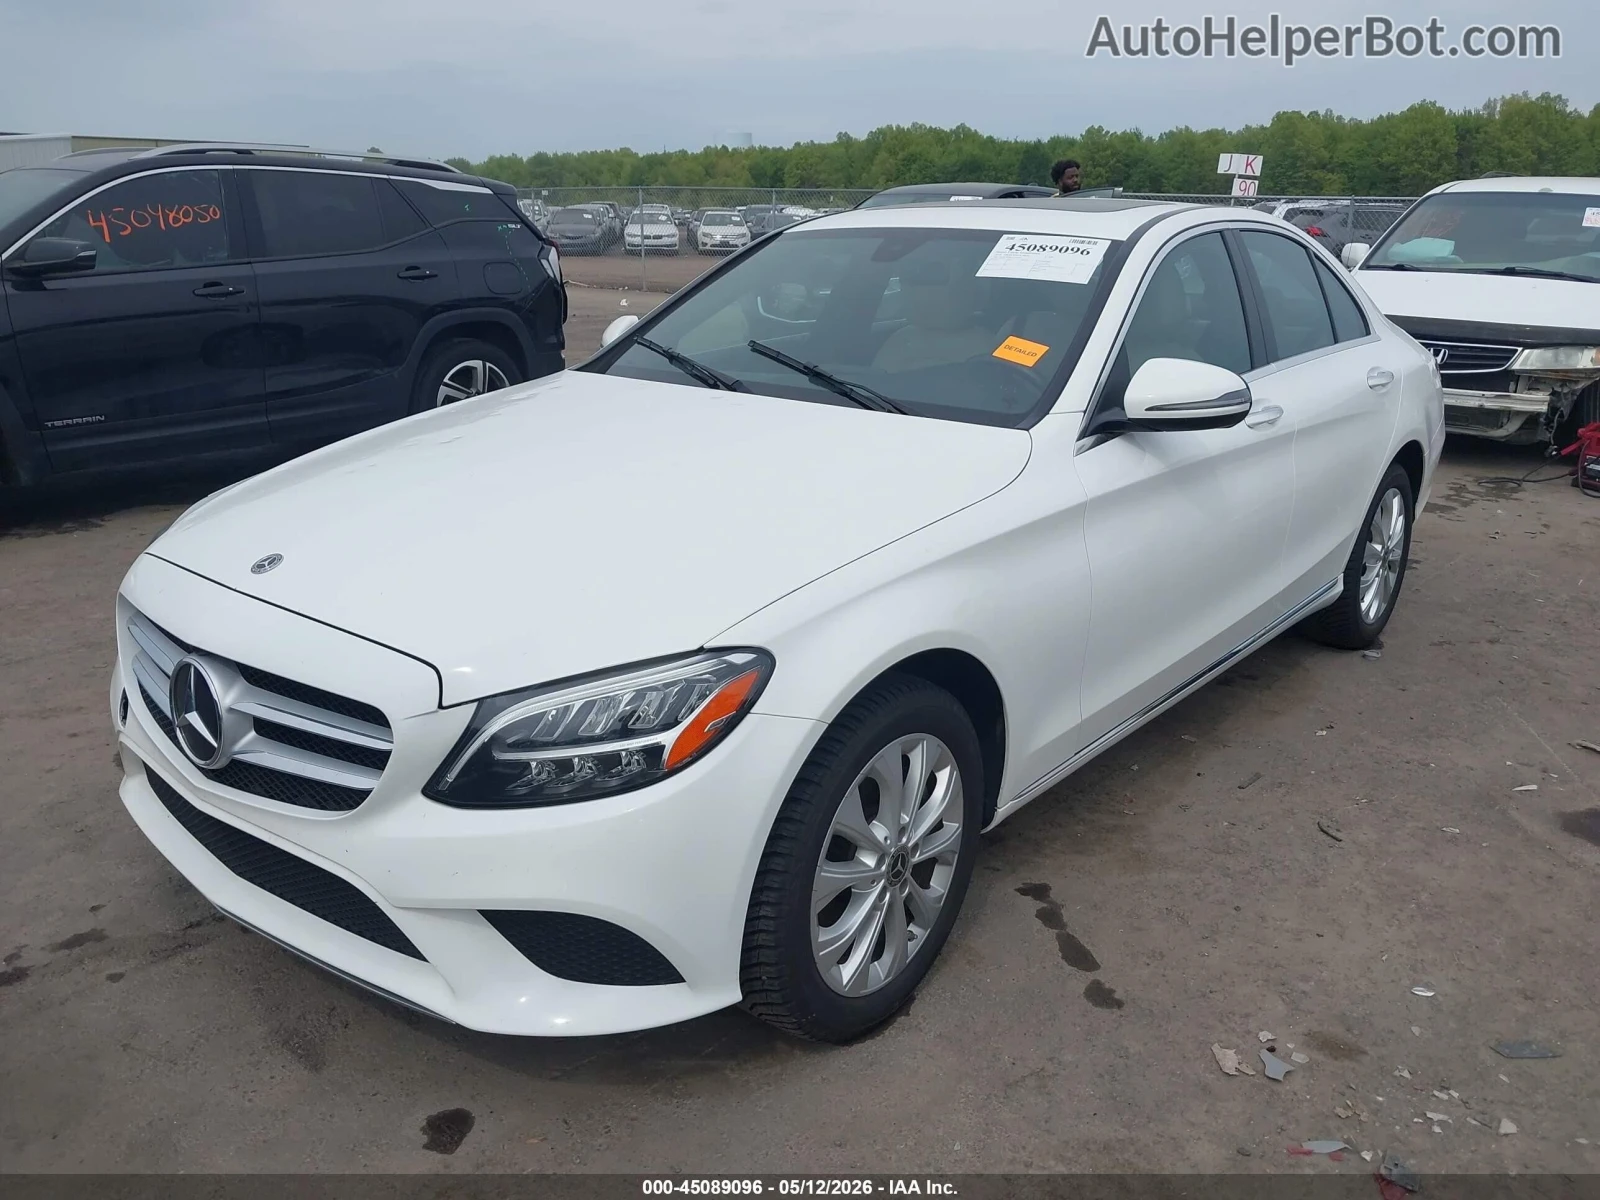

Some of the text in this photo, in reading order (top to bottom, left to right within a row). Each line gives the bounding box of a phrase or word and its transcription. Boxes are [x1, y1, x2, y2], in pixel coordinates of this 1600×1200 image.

[1224, 154, 1258, 174] J K
[1238, 180, 1257, 196] 90
[87, 203, 221, 243] 45048050
[1005, 242, 1093, 257] 45089096
[1003, 344, 1038, 358] DETAILED
[44, 415, 105, 428] TERRAIN
